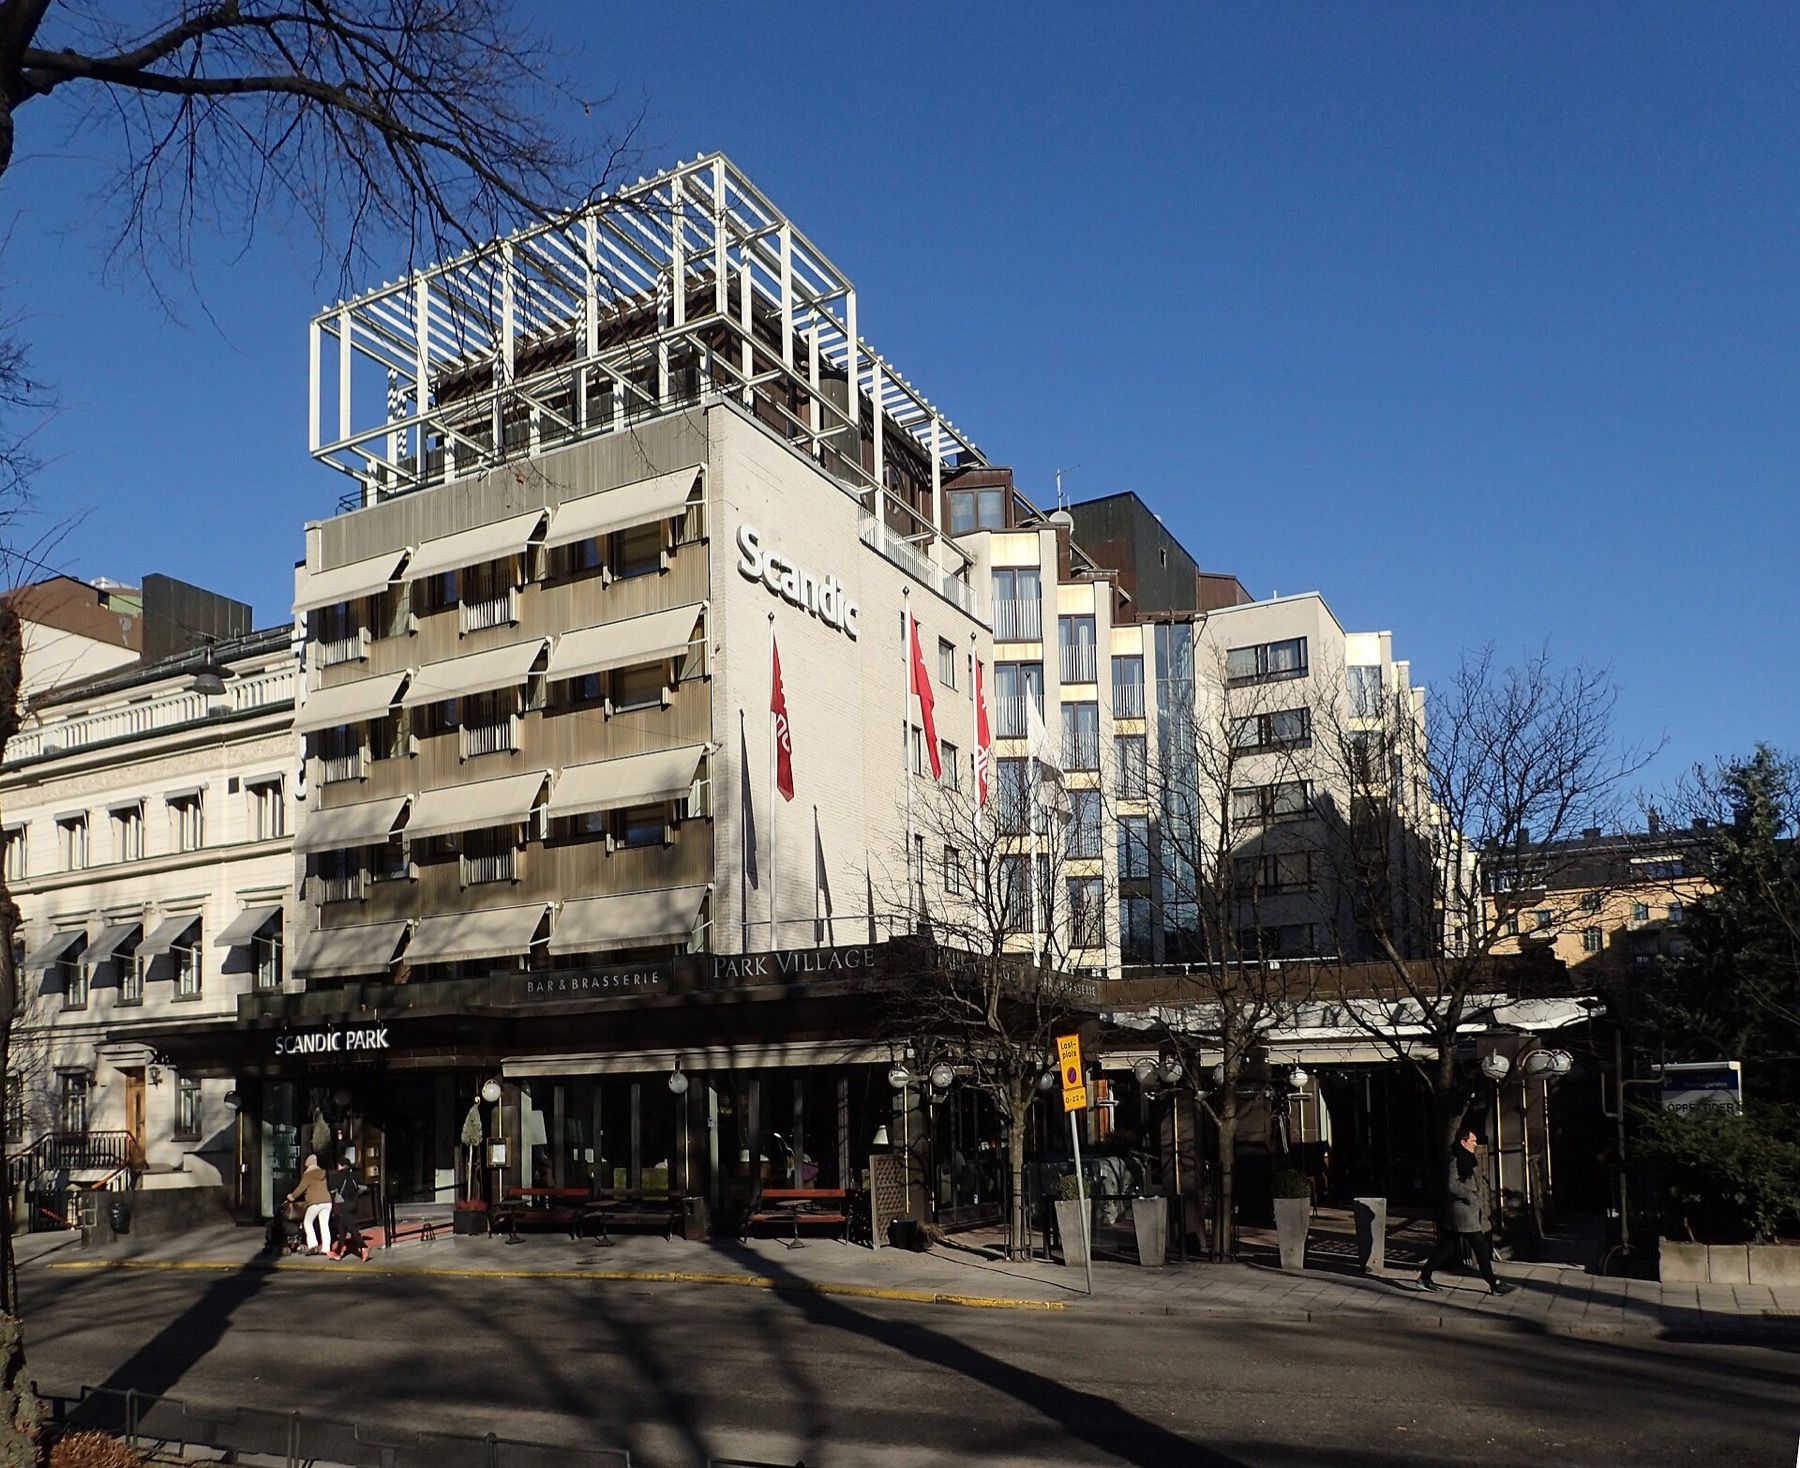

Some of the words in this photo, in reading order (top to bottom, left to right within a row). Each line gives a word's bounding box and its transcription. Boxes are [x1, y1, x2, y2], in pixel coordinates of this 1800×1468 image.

[736, 523, 860, 642] Scandic
[713, 957, 769, 979] PARK
[775, 948, 875, 974] VILLAGE
[571, 971, 659, 990] BRASSERIE
[275, 1032, 342, 1055] SCANDIC
[346, 1028, 390, 1050] PARK
